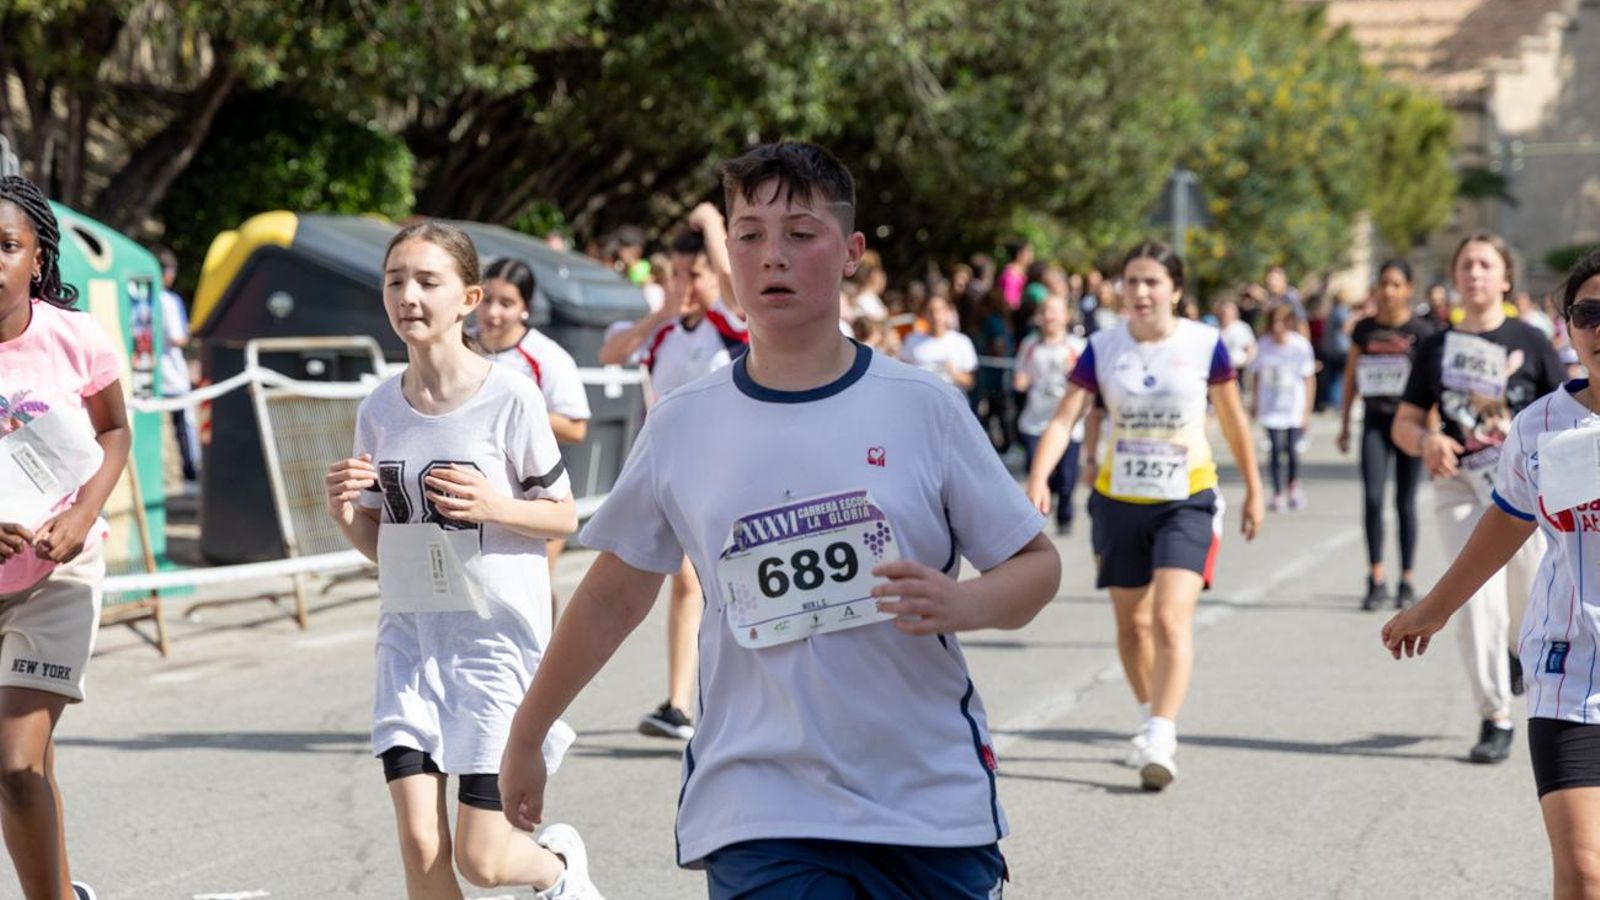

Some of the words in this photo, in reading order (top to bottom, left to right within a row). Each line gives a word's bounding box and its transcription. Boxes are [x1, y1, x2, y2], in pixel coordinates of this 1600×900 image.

[1124, 460, 1178, 478] 1257
[742, 511, 799, 544] XXXVI
[798, 501, 838, 518] CARRERA
[807, 515, 822, 529] LA
[829, 506, 870, 524] GLORIA
[758, 541, 858, 598] 689
[11, 658, 39, 674] NEW
[42, 662, 72, 680] YORK
